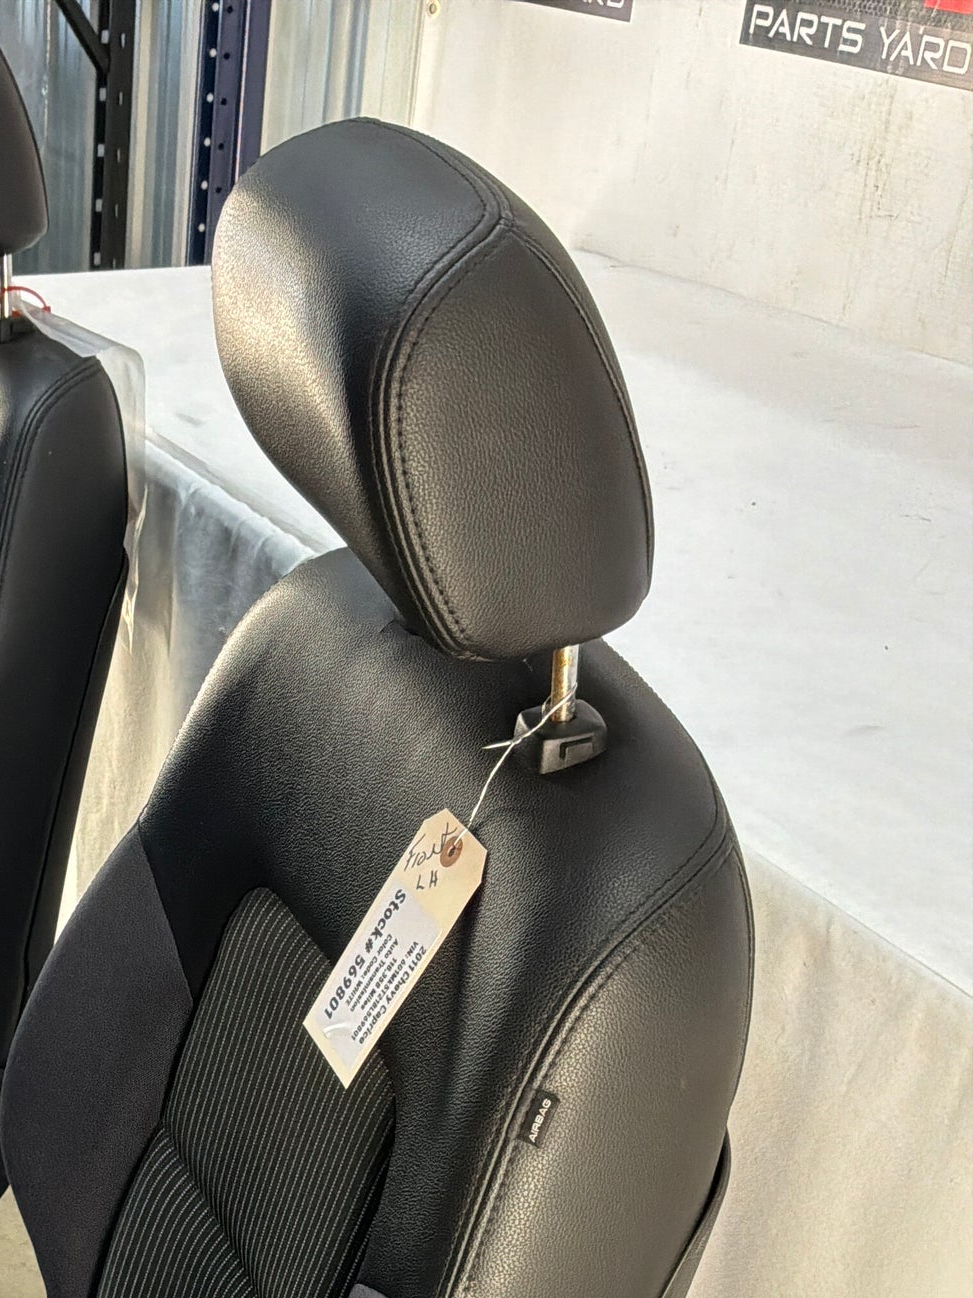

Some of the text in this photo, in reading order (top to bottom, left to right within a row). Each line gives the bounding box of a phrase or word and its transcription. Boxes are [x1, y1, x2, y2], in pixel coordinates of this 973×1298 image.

[749, 5, 972, 75] PARTS YARD
[324, 889, 405, 1019] Stock# 569801
[345, 933, 392, 1004] Color Code: WHITE
[350, 938, 398, 1011] Auto Transmission
[359, 945, 426, 1043] 2011 Chevy Caprice
[360, 988, 376, 1009] Miles
[528, 1099, 552, 1143] AIRBAG
